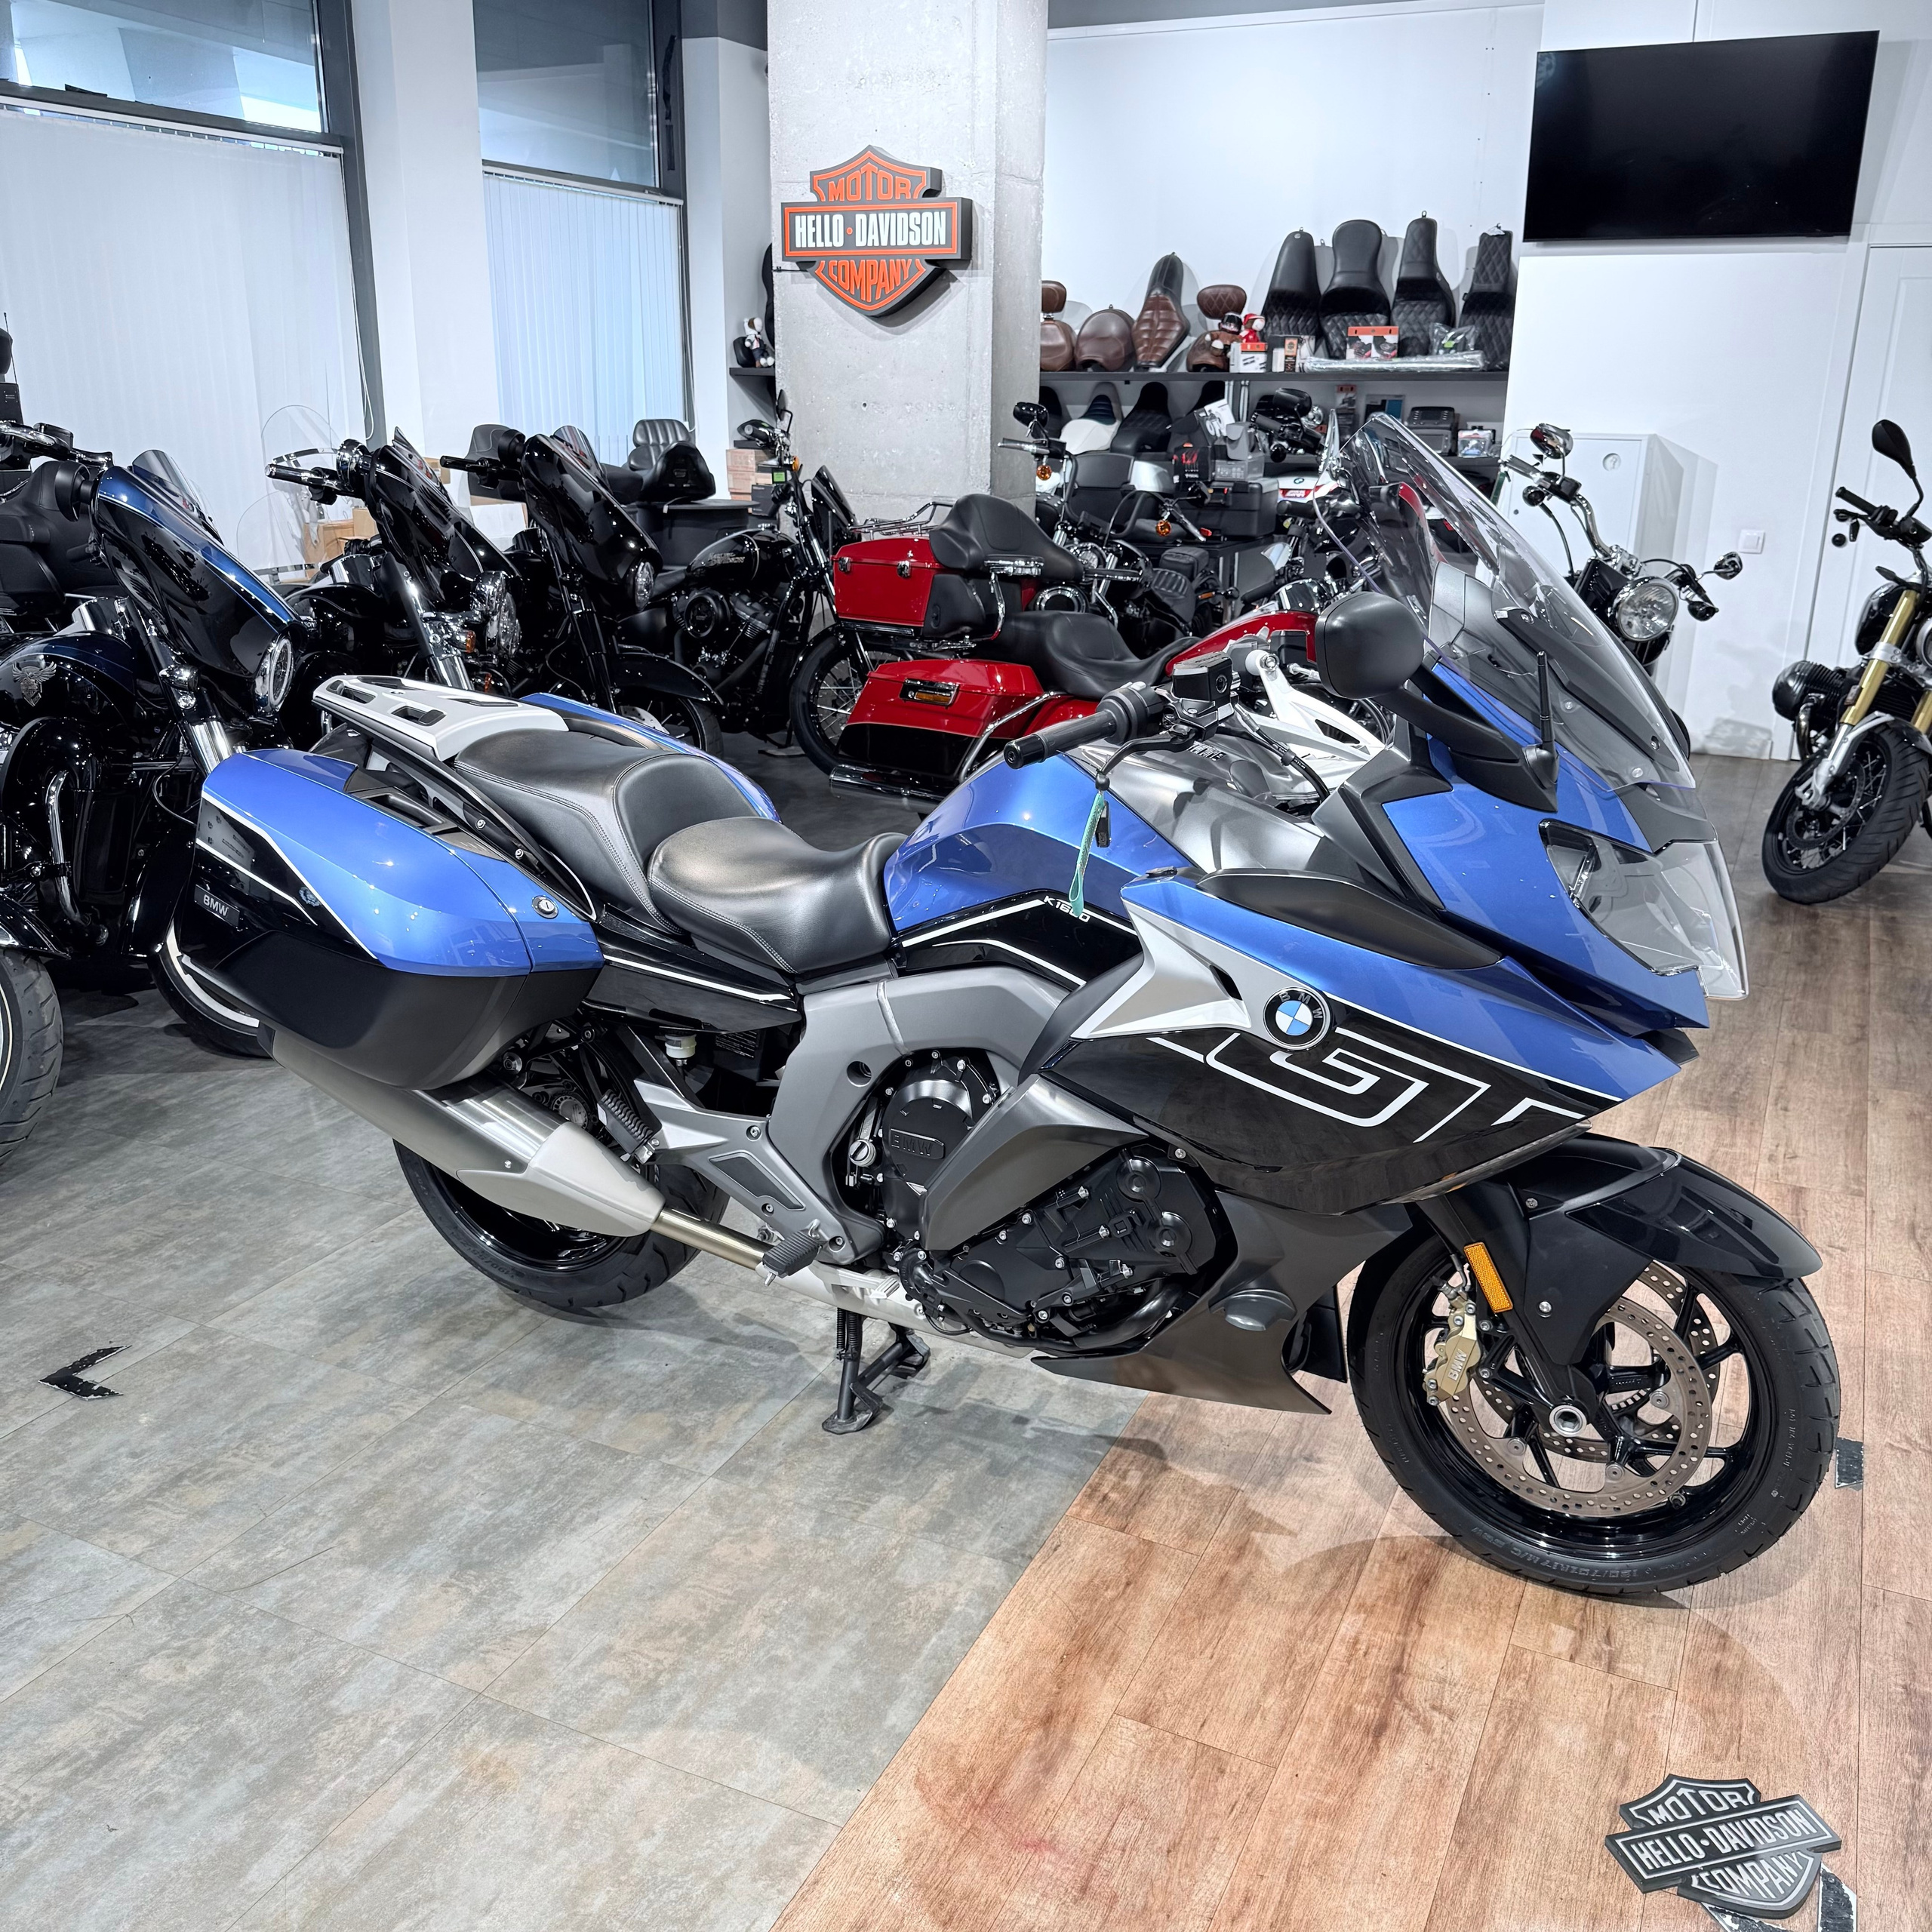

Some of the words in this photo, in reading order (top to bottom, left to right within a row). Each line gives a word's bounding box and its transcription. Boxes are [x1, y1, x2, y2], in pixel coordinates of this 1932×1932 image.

[828, 162, 912, 202] MOTOR
[795, 214, 844, 248] HELLO
[855, 211, 946, 247] DAVIDSON
[828, 259, 912, 302] COMPANY
[203, 894, 229, 916] BMW
[1278, 991, 1323, 1019] BMW
[891, 1134, 933, 1157] BMW
[1448, 1348, 1467, 1381] BMW
[1647, 1787, 1749, 1826] MOTOR
[1631, 1832, 1706, 1870] HELLO
[1701, 1808, 1817, 1854] DAVIDSON
[1700, 1850, 1804, 1899] COMPANY
